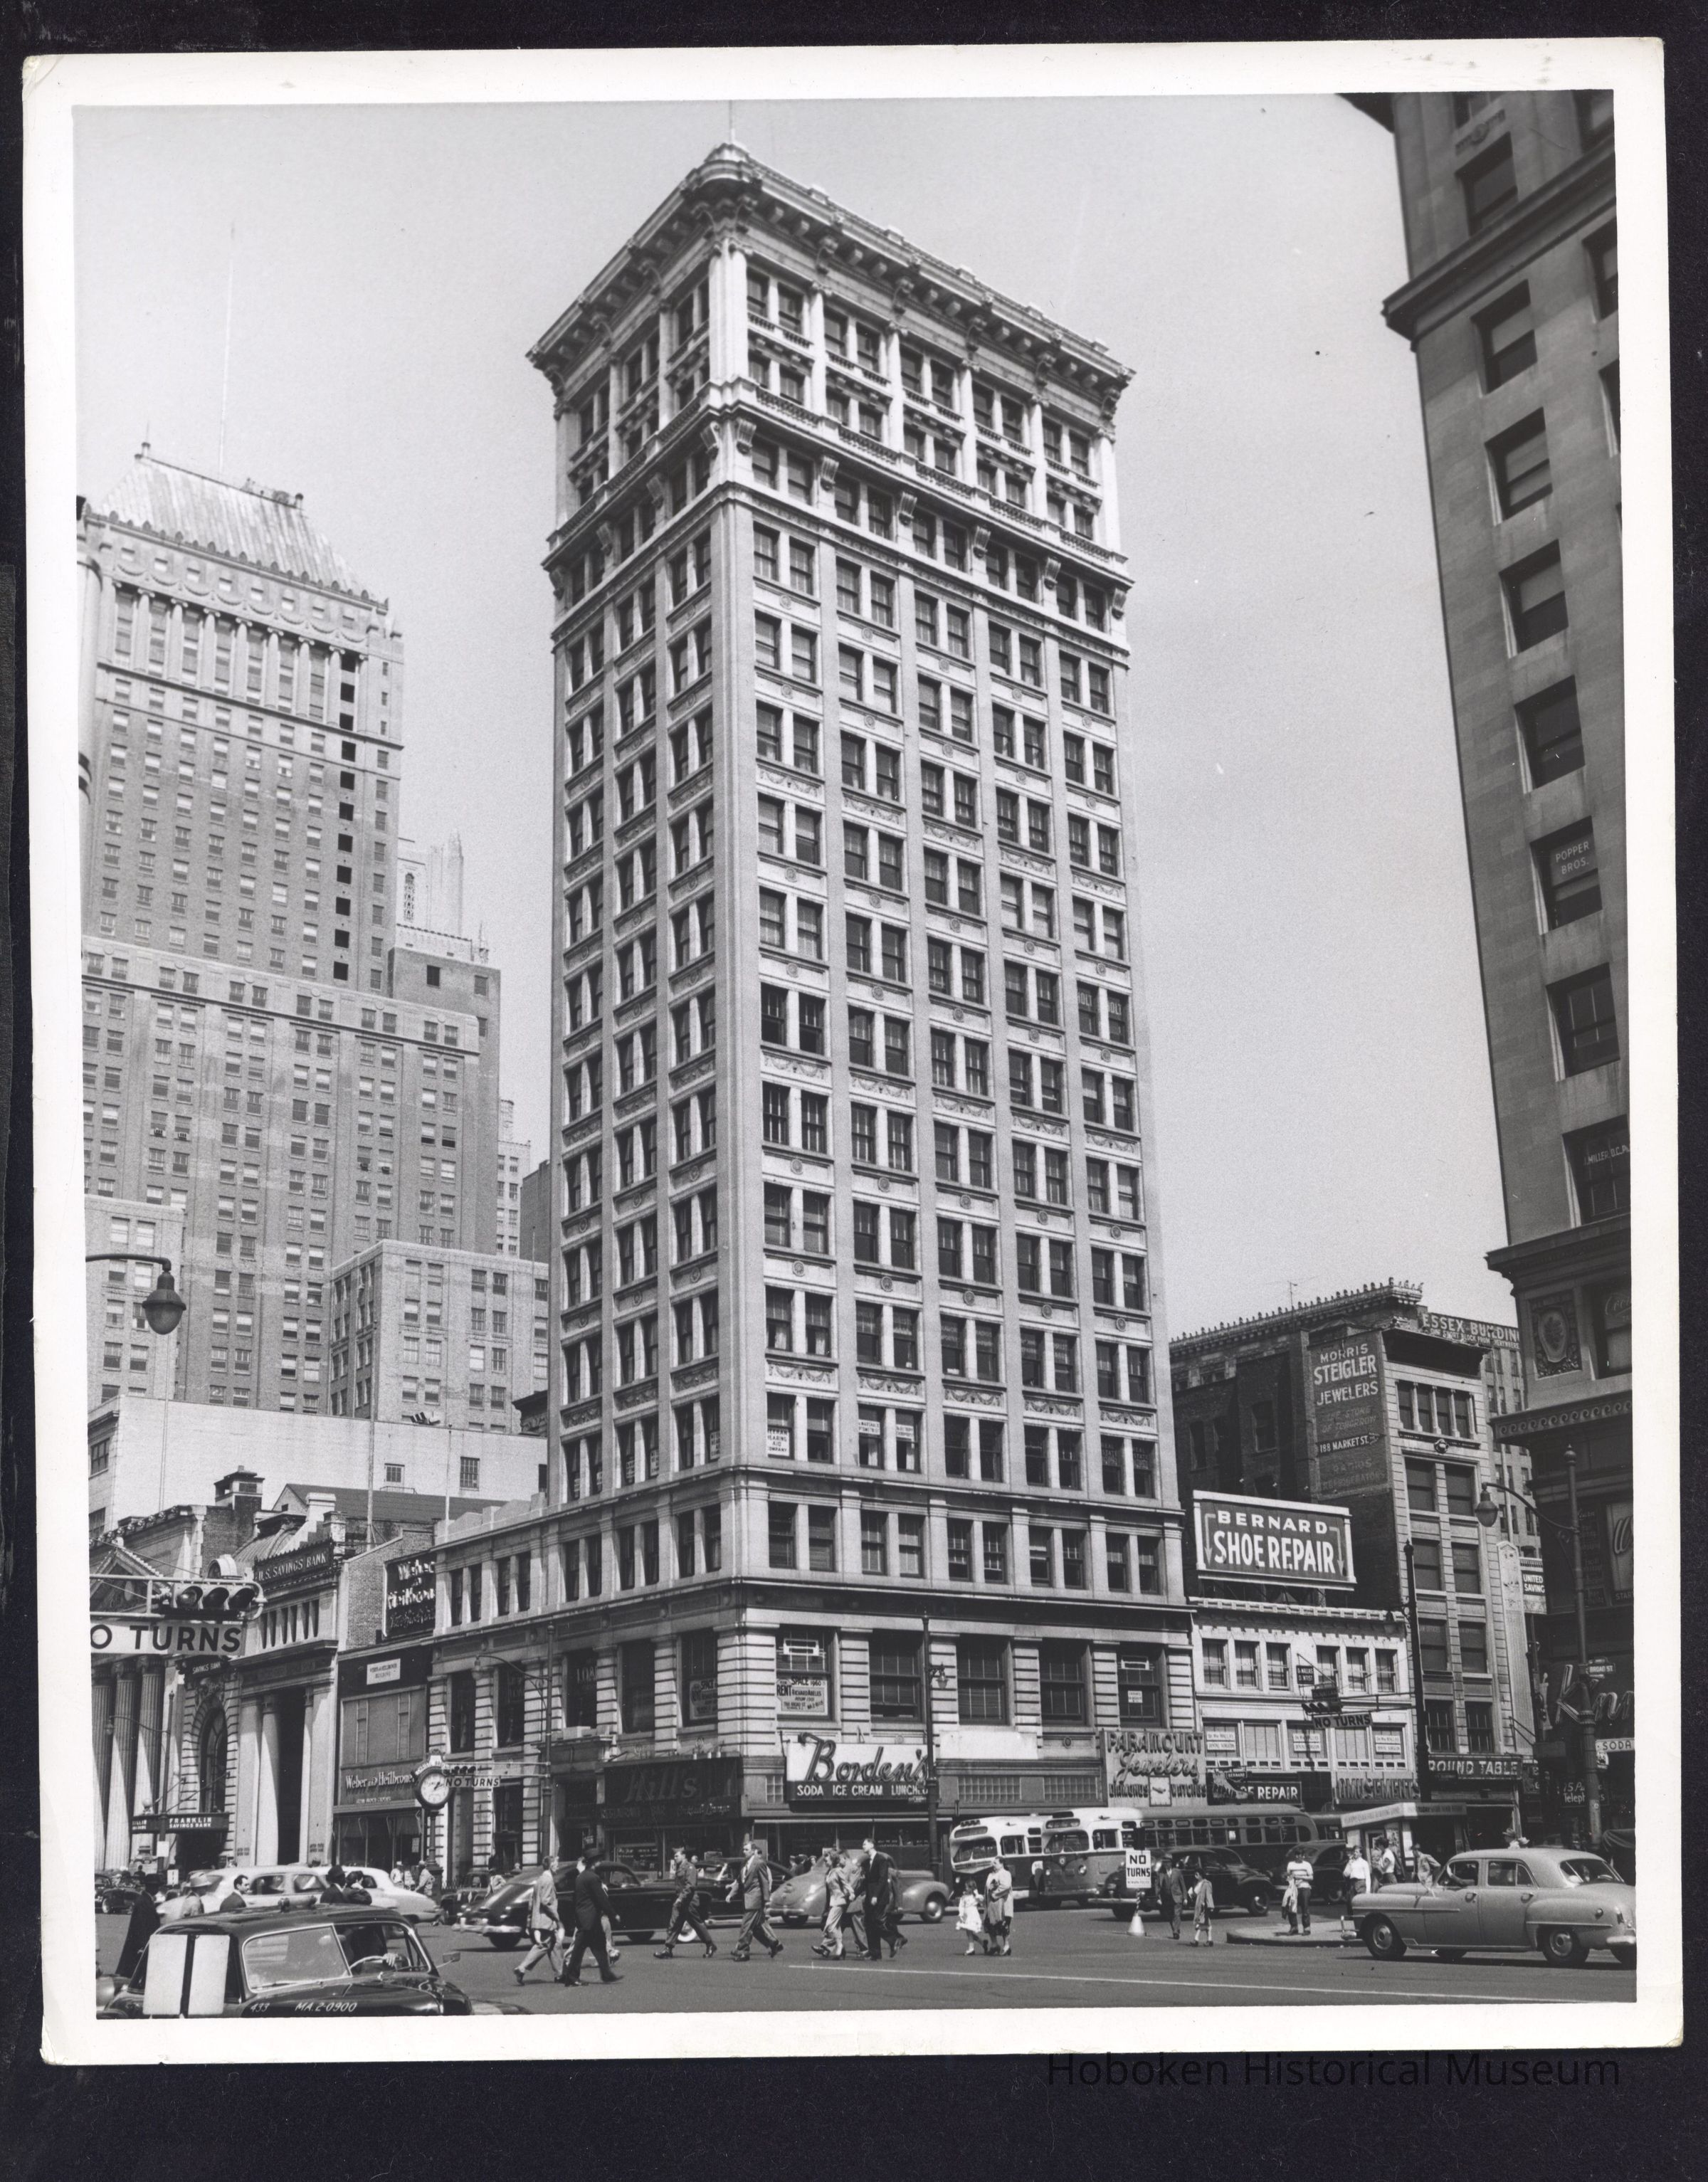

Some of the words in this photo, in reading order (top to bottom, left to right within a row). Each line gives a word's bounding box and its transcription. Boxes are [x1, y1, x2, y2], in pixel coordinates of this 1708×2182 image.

[1556, 841, 1589, 863] POPPER
[1561, 857, 1589, 875] BROS.
[1422, 1313, 1465, 1333] ESSEX
[1470, 1322, 1520, 1342] BUILDIN
[1320, 1344, 1369, 1364] MORRIS
[1314, 1354, 1378, 1386] STEIGLER
[1317, 1381, 1378, 1406] JEWELERS
[1319, 1443, 1332, 1453] 188
[1332, 1437, 1360, 1450] MARKET
[1218, 1510, 1327, 1534] BERNARD
[1213, 1531, 1265, 1568] SHOE
[1267, 1536, 1336, 1574] REPAIR
[272, 1559, 304, 1578] SAVINGS
[305, 1553, 326, 1568] BANK
[1523, 1574, 1543, 1583] UNITED
[90, 1624, 112, 1650] O
[130, 1625, 241, 1653] TURNS
[210, 1660, 222, 1672] BANK
[776, 1685, 792, 1697] RENT
[1316, 1717, 1331, 1728] NO
[1334, 1715, 1371, 1727] TURNS
[1107, 1732, 1203, 1754] PARAMOUNT
[1603, 1740, 1632, 1751] SODA
[797, 1732, 928, 1783] Borden's
[1113, 1750, 1200, 1785] Jewelers
[1428, 1760, 1474, 1774] ROUND
[1479, 1760, 1518, 1776] TABLE
[345, 1775, 367, 1789] Weber
[446, 1778, 462, 1788] NO
[465, 1777, 500, 1787] TURNS
[796, 1784, 824, 1796] SODA
[832, 1785, 847, 1796] ICE
[851, 1784, 884, 1796] CREAM
[1337, 1778, 1420, 1800] AMUSEMENTS
[1171, 1783, 1206, 1798] WATCHES
[1258, 1786, 1299, 1800] REPAIR
[1129, 1855, 1146, 1865] NO
[1127, 1867, 1151, 1877] TURNS
[250, 2003, 270, 2013] 433
